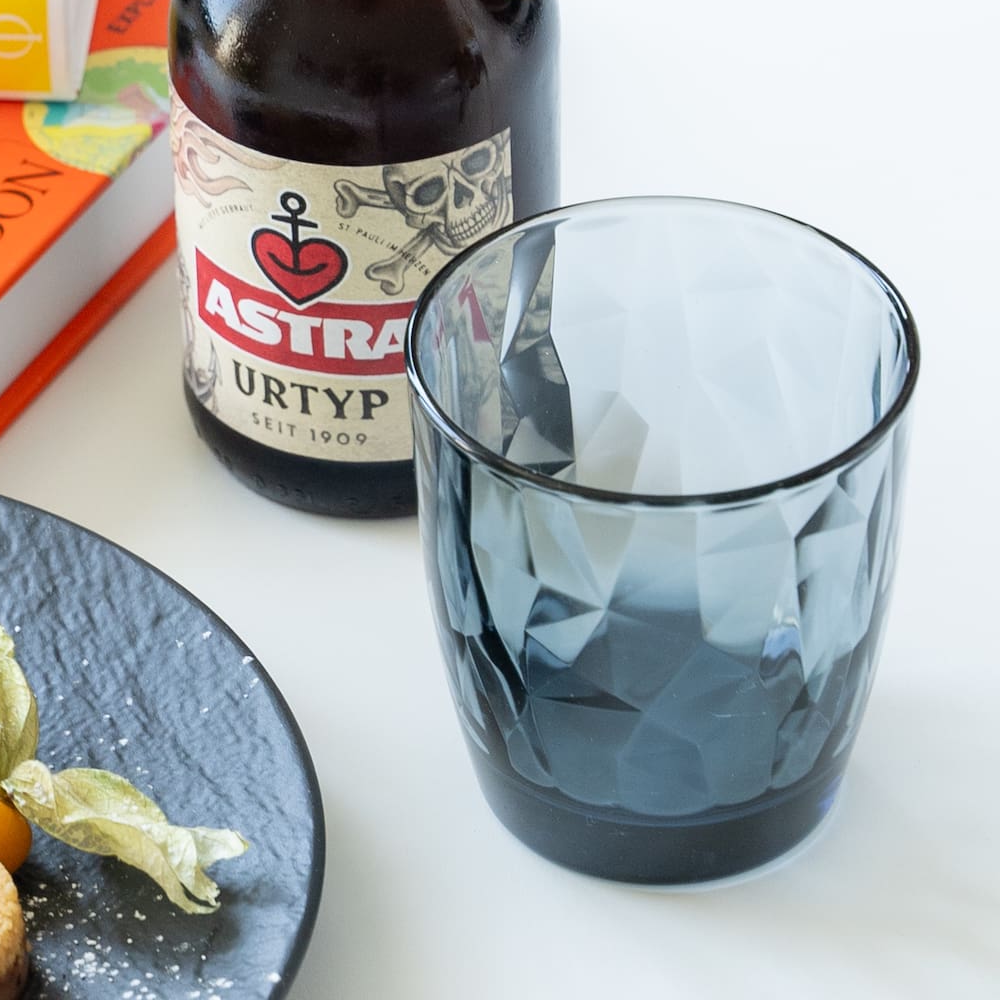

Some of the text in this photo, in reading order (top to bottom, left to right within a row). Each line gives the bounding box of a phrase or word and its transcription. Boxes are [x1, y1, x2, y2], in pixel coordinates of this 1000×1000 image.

[355, 227, 386, 246] PAULI
[204, 278, 405, 361] ASTRA
[232, 358, 390, 421] URTYP
[251, 411, 368, 446] SEIT 1909
